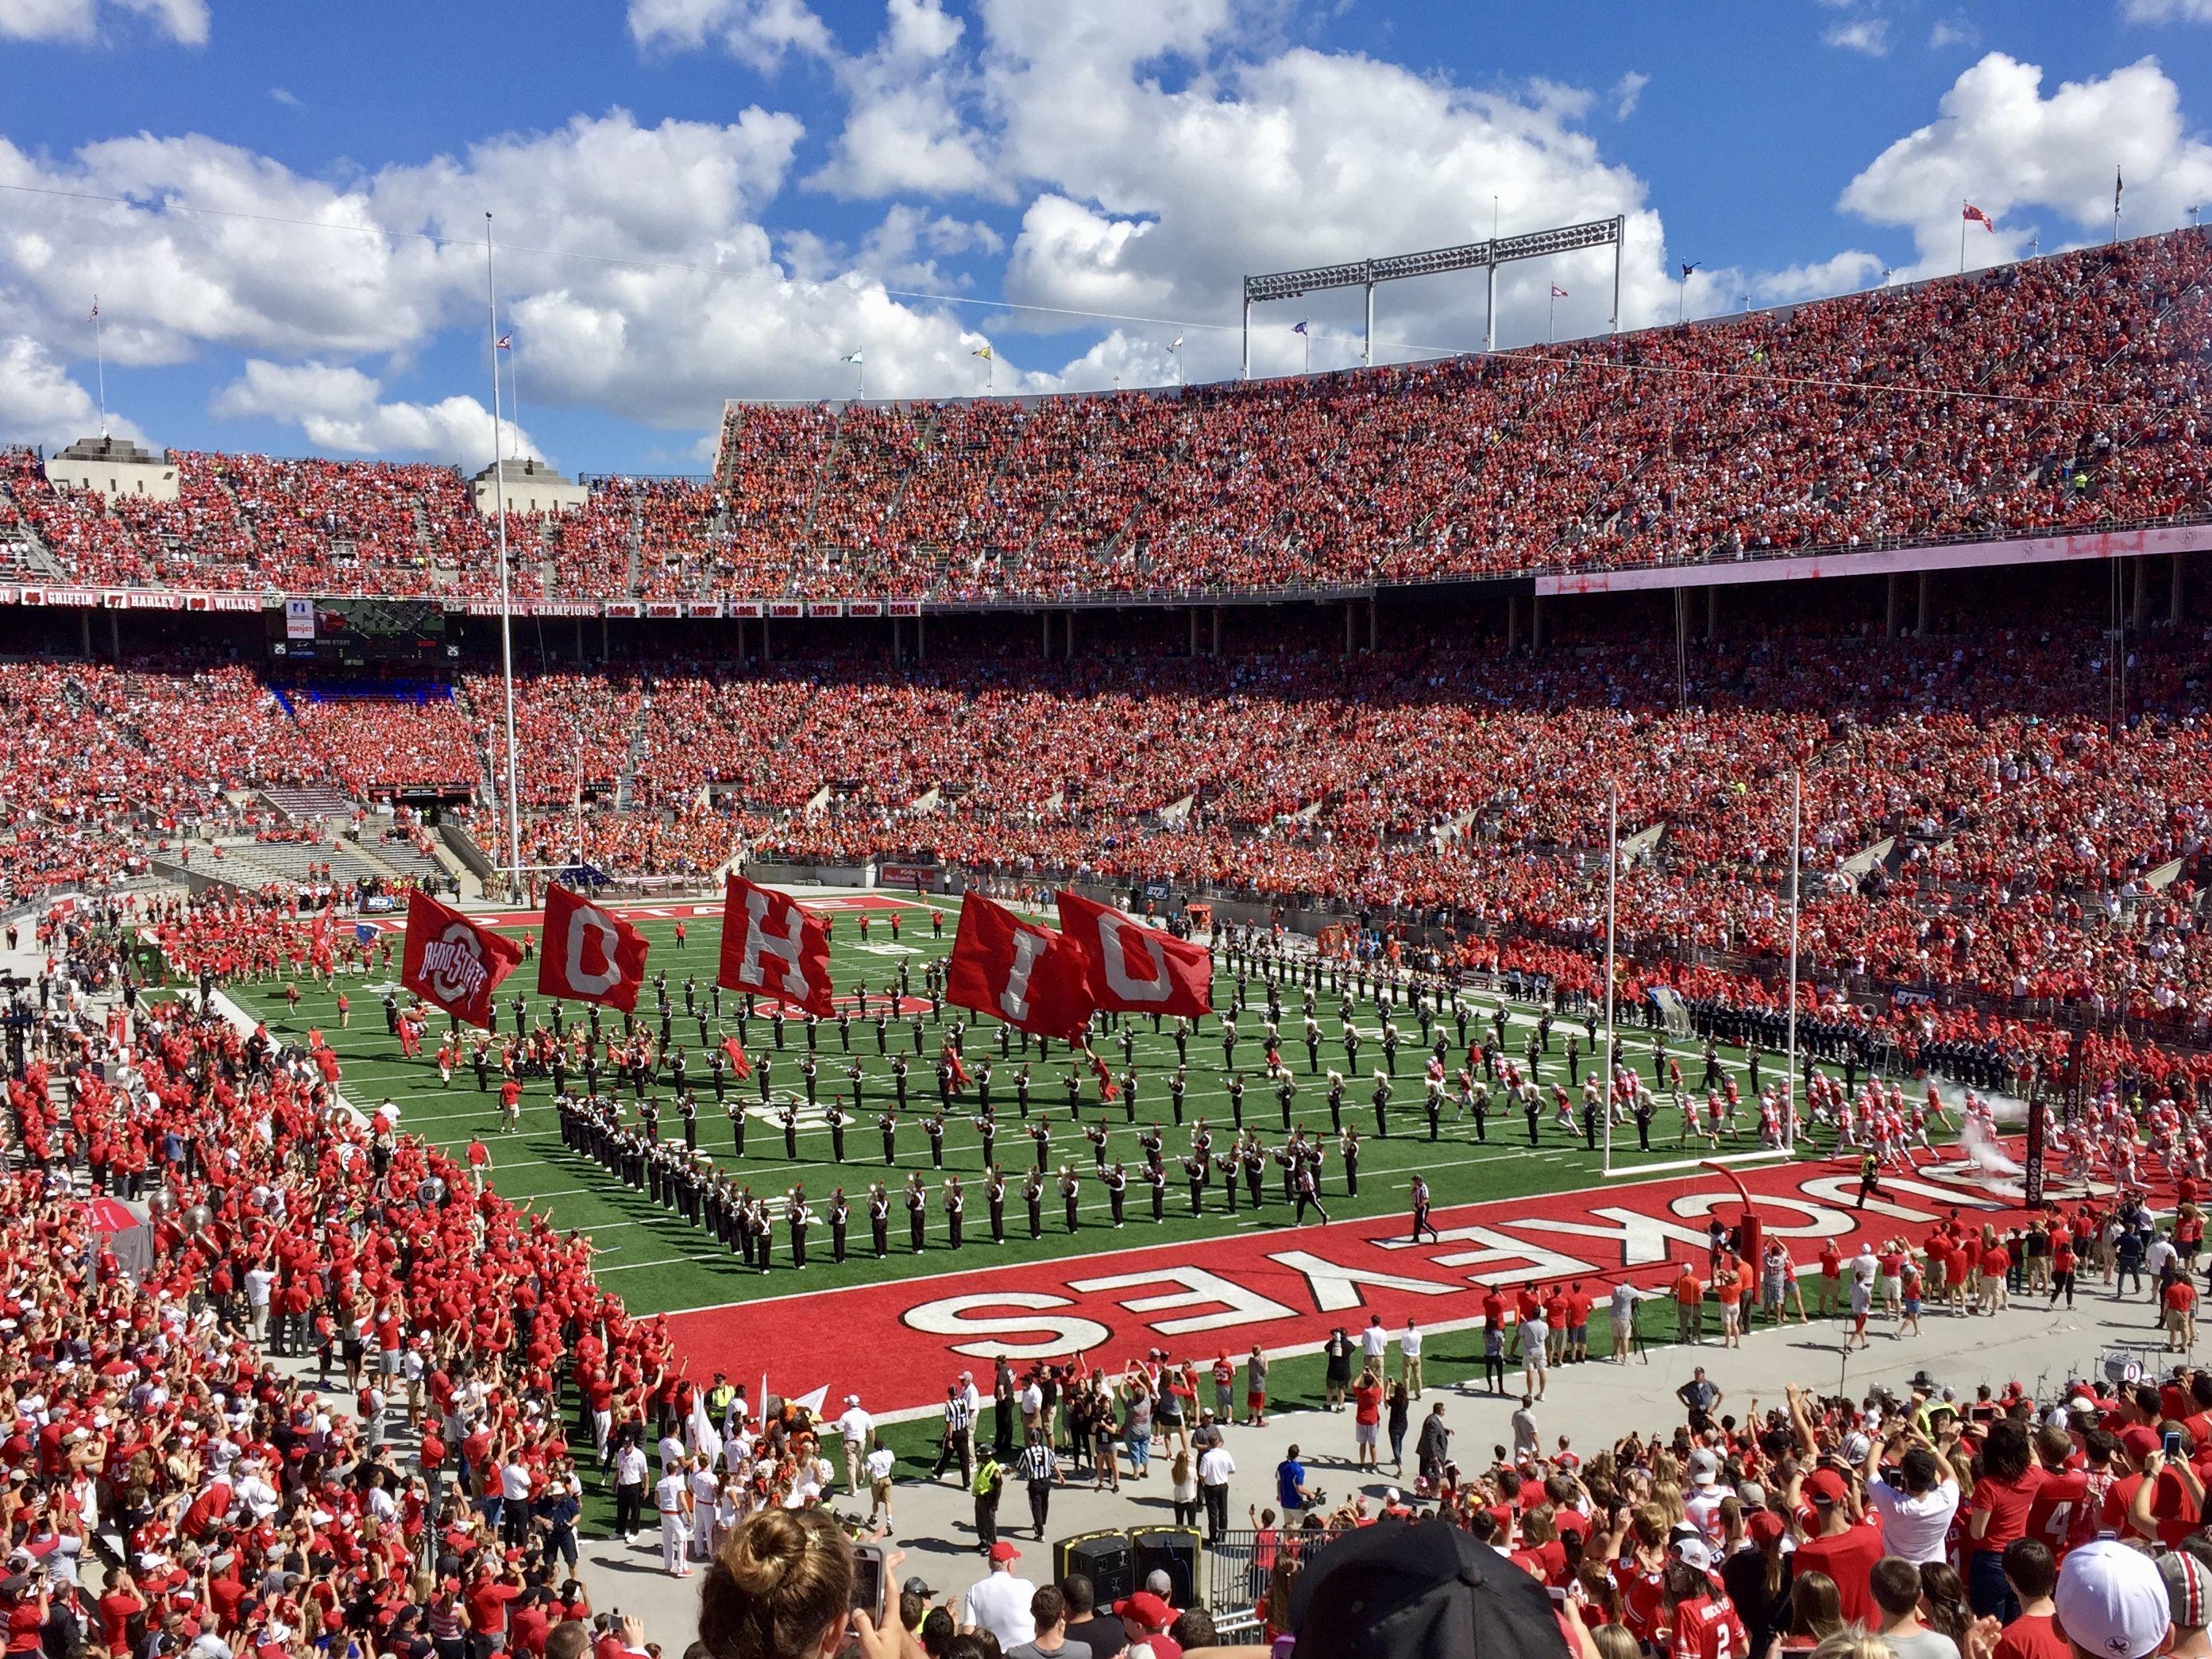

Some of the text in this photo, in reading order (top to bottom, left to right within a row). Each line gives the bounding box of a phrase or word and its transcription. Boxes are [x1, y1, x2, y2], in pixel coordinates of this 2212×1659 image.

[48, 592, 93, 605] GRIFFIN
[131, 596, 175, 608] HARLEY
[214, 598, 256, 610] WILLIS
[470, 604, 596, 615] NATIONAL CHAMPIONS
[851, 605, 878, 615] 2002
[890, 604, 916, 615] 2014
[288, 624, 312, 633] meijer
[565, 905, 622, 996] O
[738, 888, 809, 1002] H
[418, 941, 456, 982] OHIO
[1098, 911, 1174, 1002] O
[999, 927, 1048, 1021] I
[1895, 990, 1930, 1007] BTN
[898, 1159, 2118, 1360] BUCKEYES
[1214, 1367, 1229, 1381] 25
[1033, 1453, 1043, 1466] F
[2045, 1501, 2072, 1545] 4
[1717, 1622, 1731, 1659] 2
